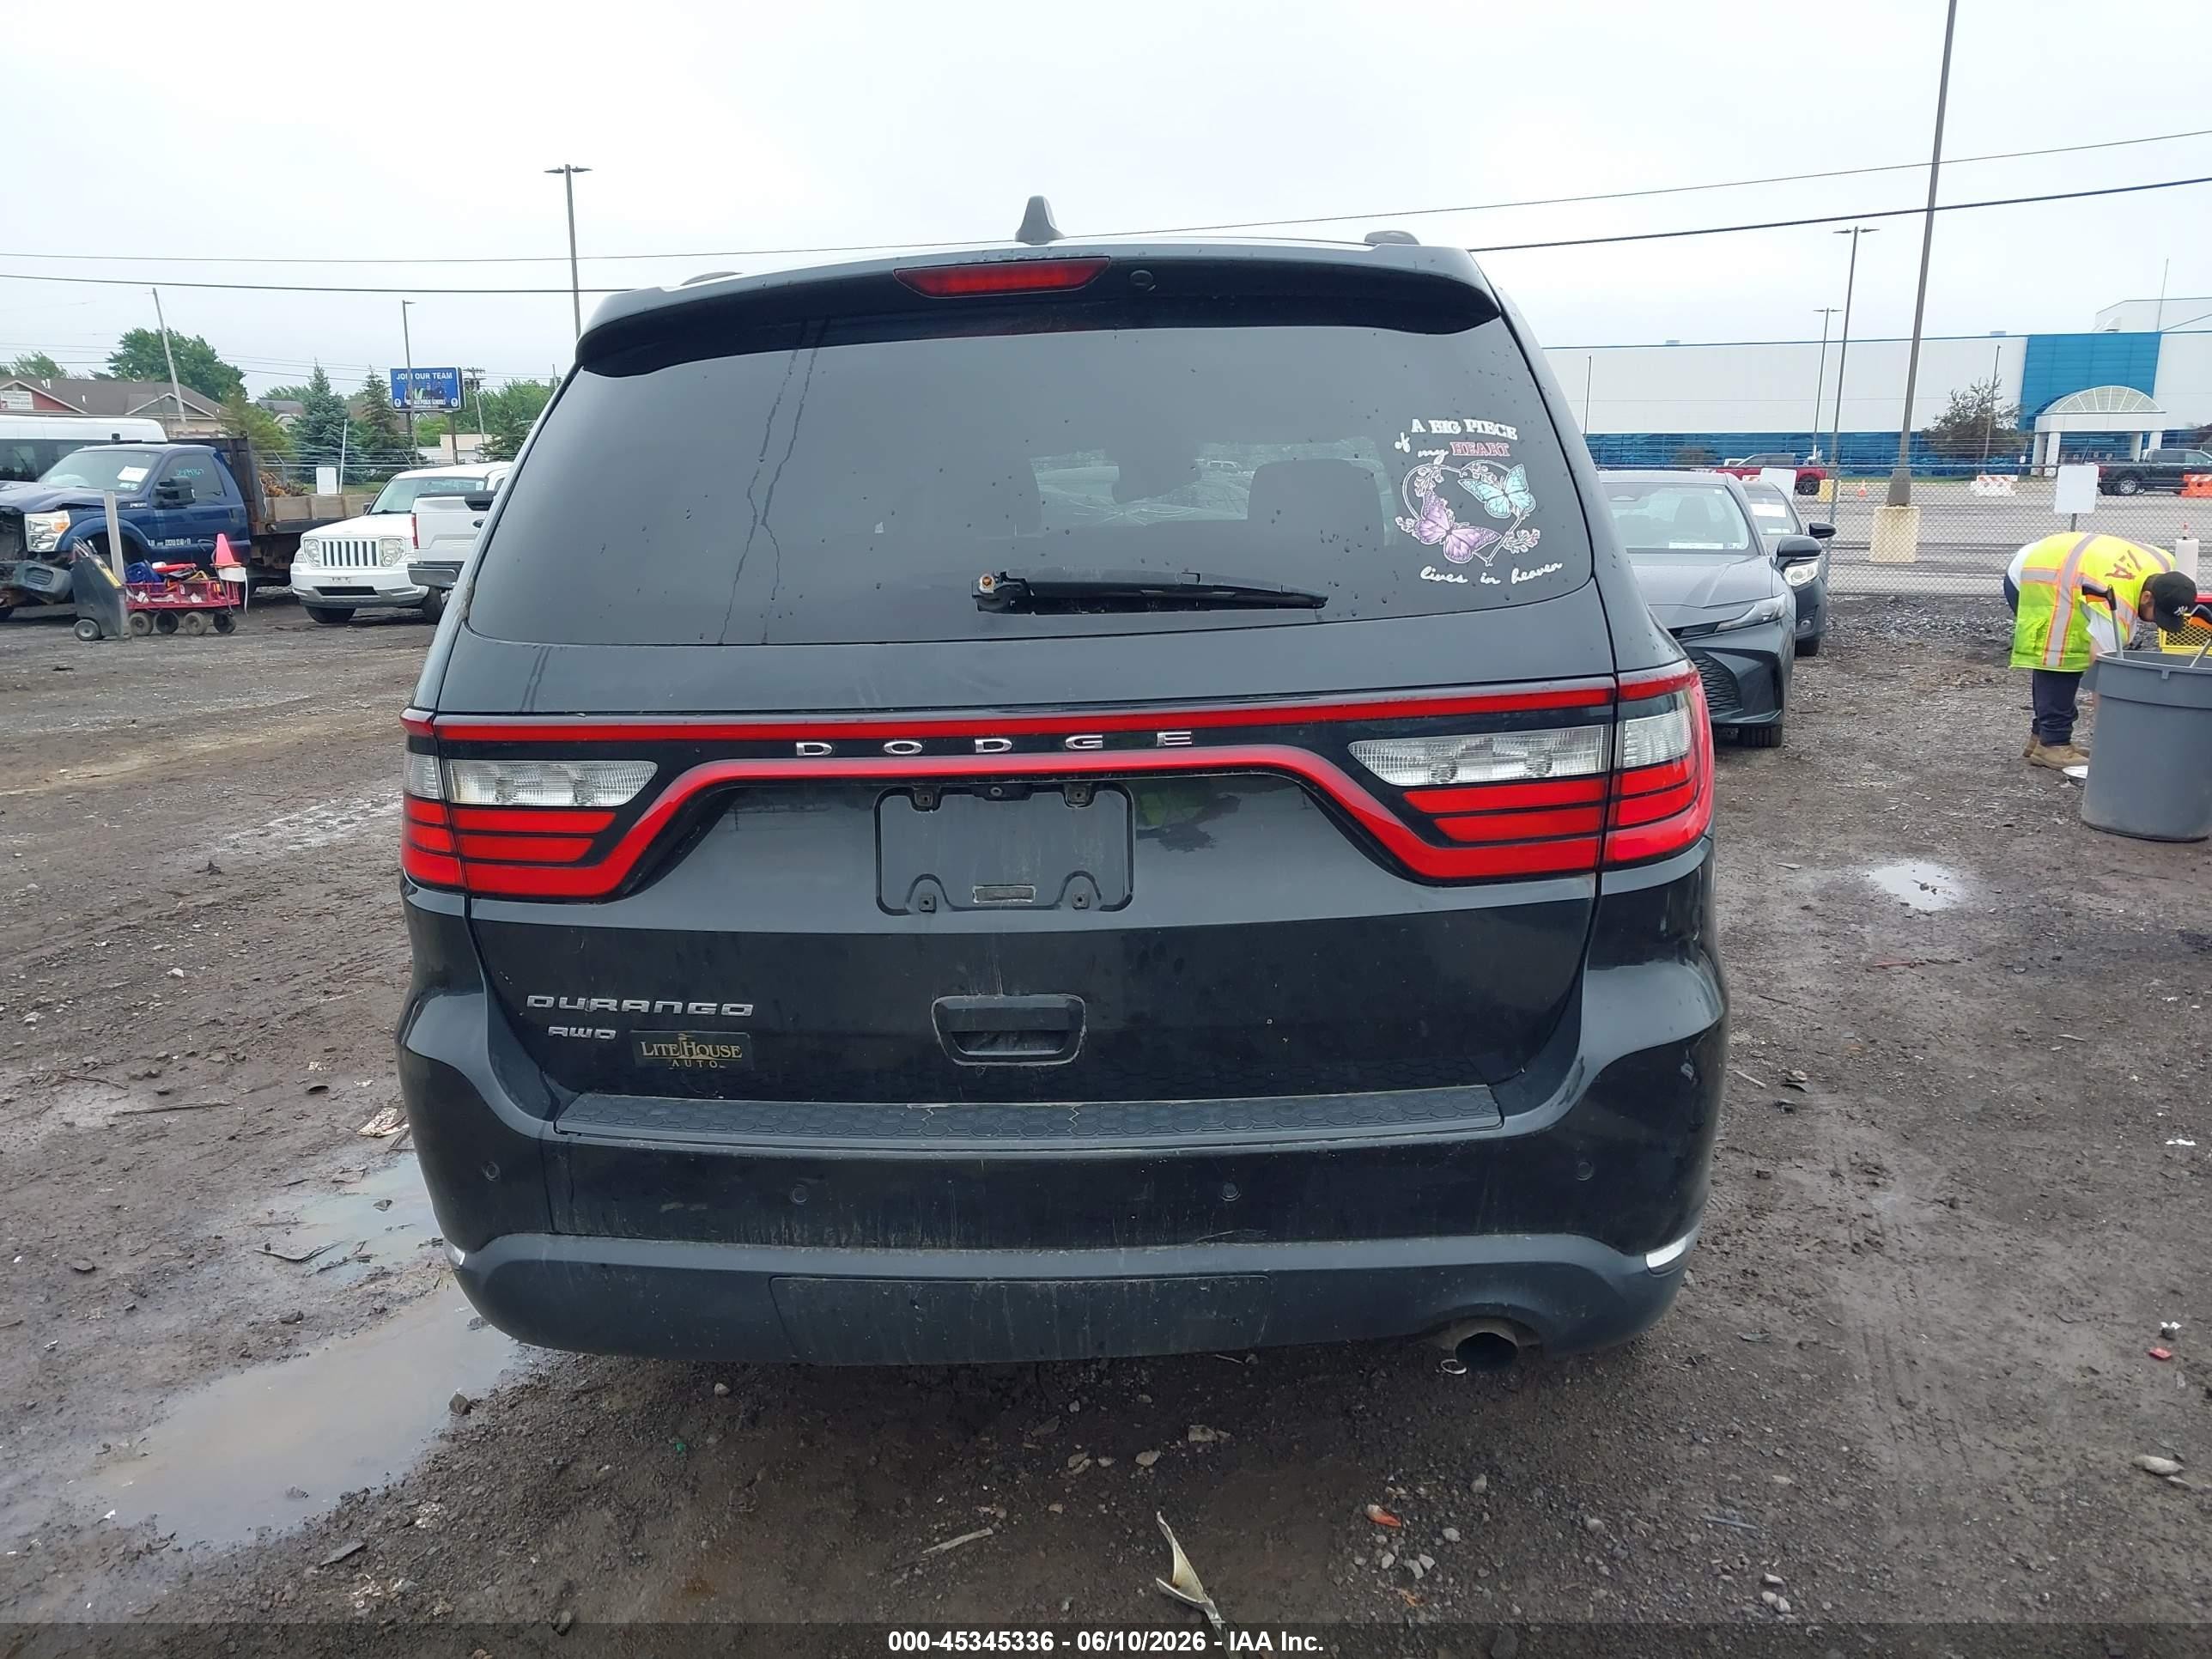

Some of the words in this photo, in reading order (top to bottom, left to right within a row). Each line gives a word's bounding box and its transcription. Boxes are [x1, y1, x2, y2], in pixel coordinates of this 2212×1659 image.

[1411, 418, 1426, 433] A
[1429, 419, 1462, 434] BIG
[1463, 418, 1518, 441] PIECE
[1395, 432, 1411, 453] of
[1418, 448, 1449, 465] my
[1449, 441, 1510, 457] HEART
[1420, 566, 1468, 584] lives
[1480, 572, 1501, 585] in
[1510, 562, 1563, 585] heaven
[795, 732, 1194, 757] DODGE
[526, 995, 754, 1017] DURANGO
[548, 1026, 617, 1040] AWD
[671, 1059, 720, 1068] AUTO
